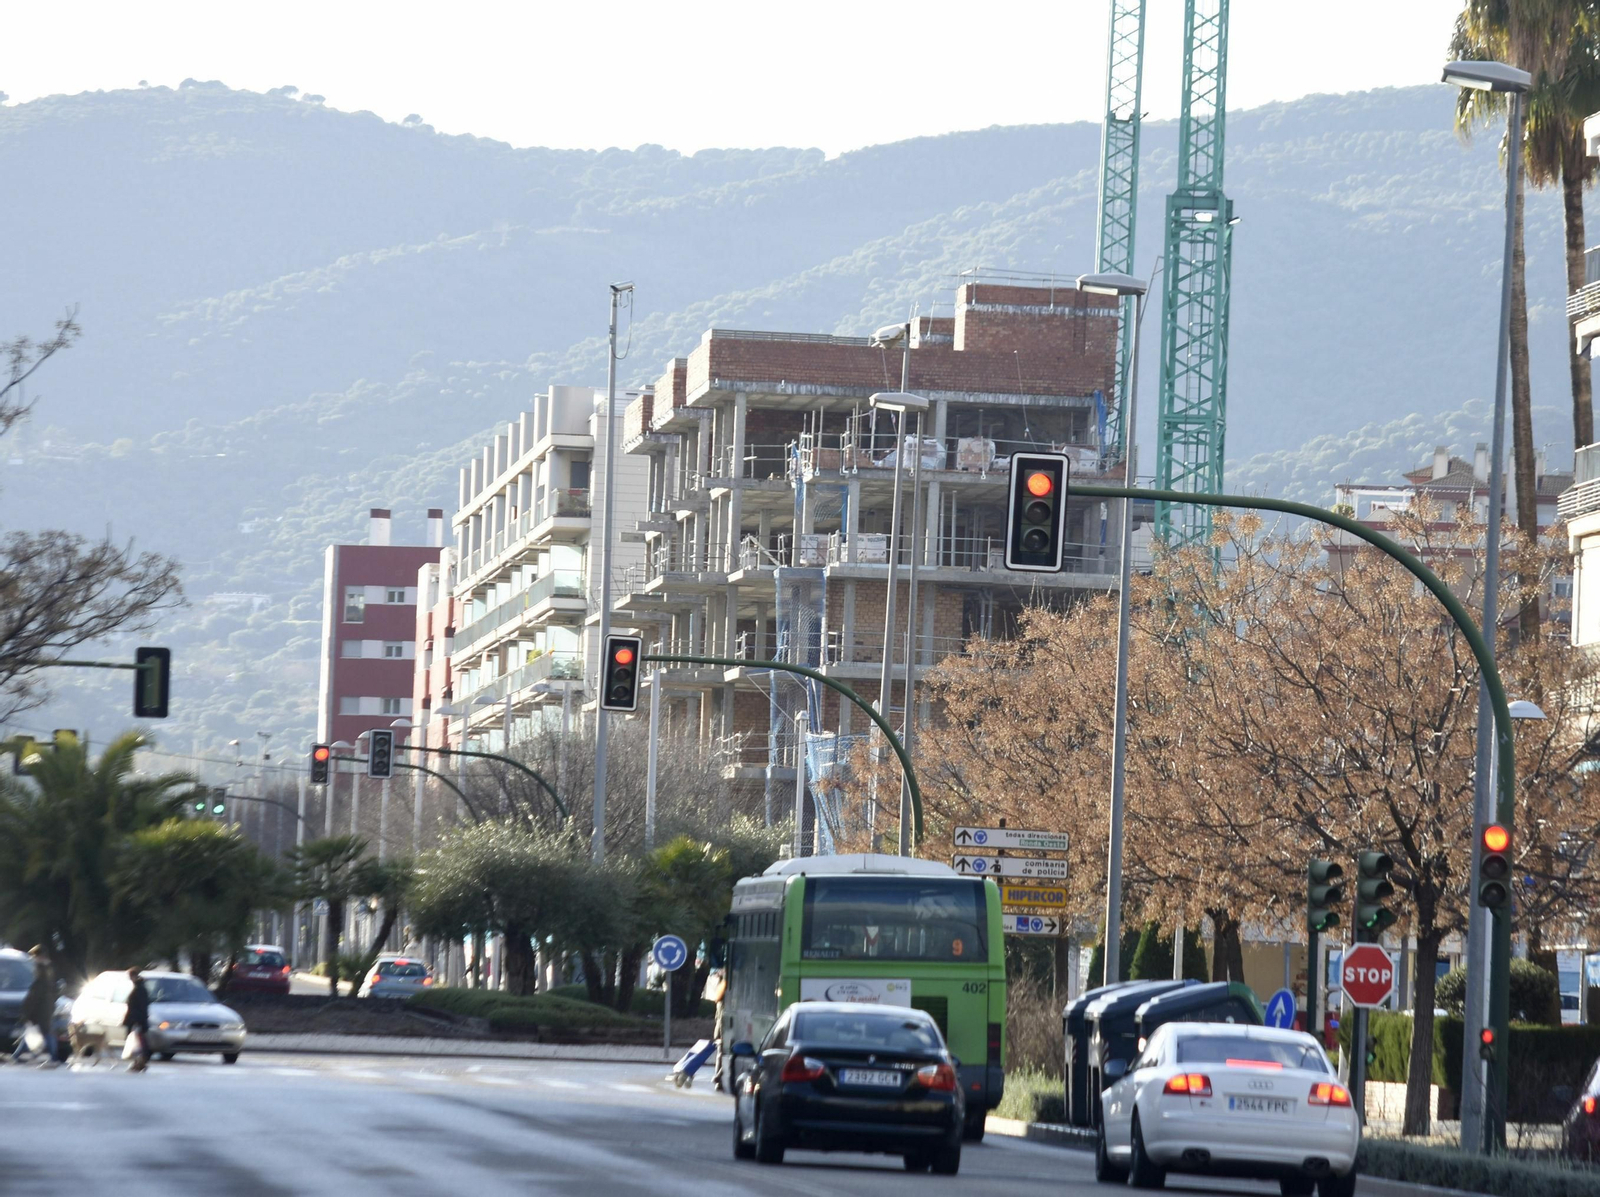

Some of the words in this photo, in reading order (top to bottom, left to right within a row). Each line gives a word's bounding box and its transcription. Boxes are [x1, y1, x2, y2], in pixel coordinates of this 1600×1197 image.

[1027, 832, 1066, 840] direcciones
[1008, 889, 1063, 903] HIPERCOR
[952, 939, 963, 955] 9
[1344, 966, 1391, 985] STOP
[962, 982, 986, 994] 402
